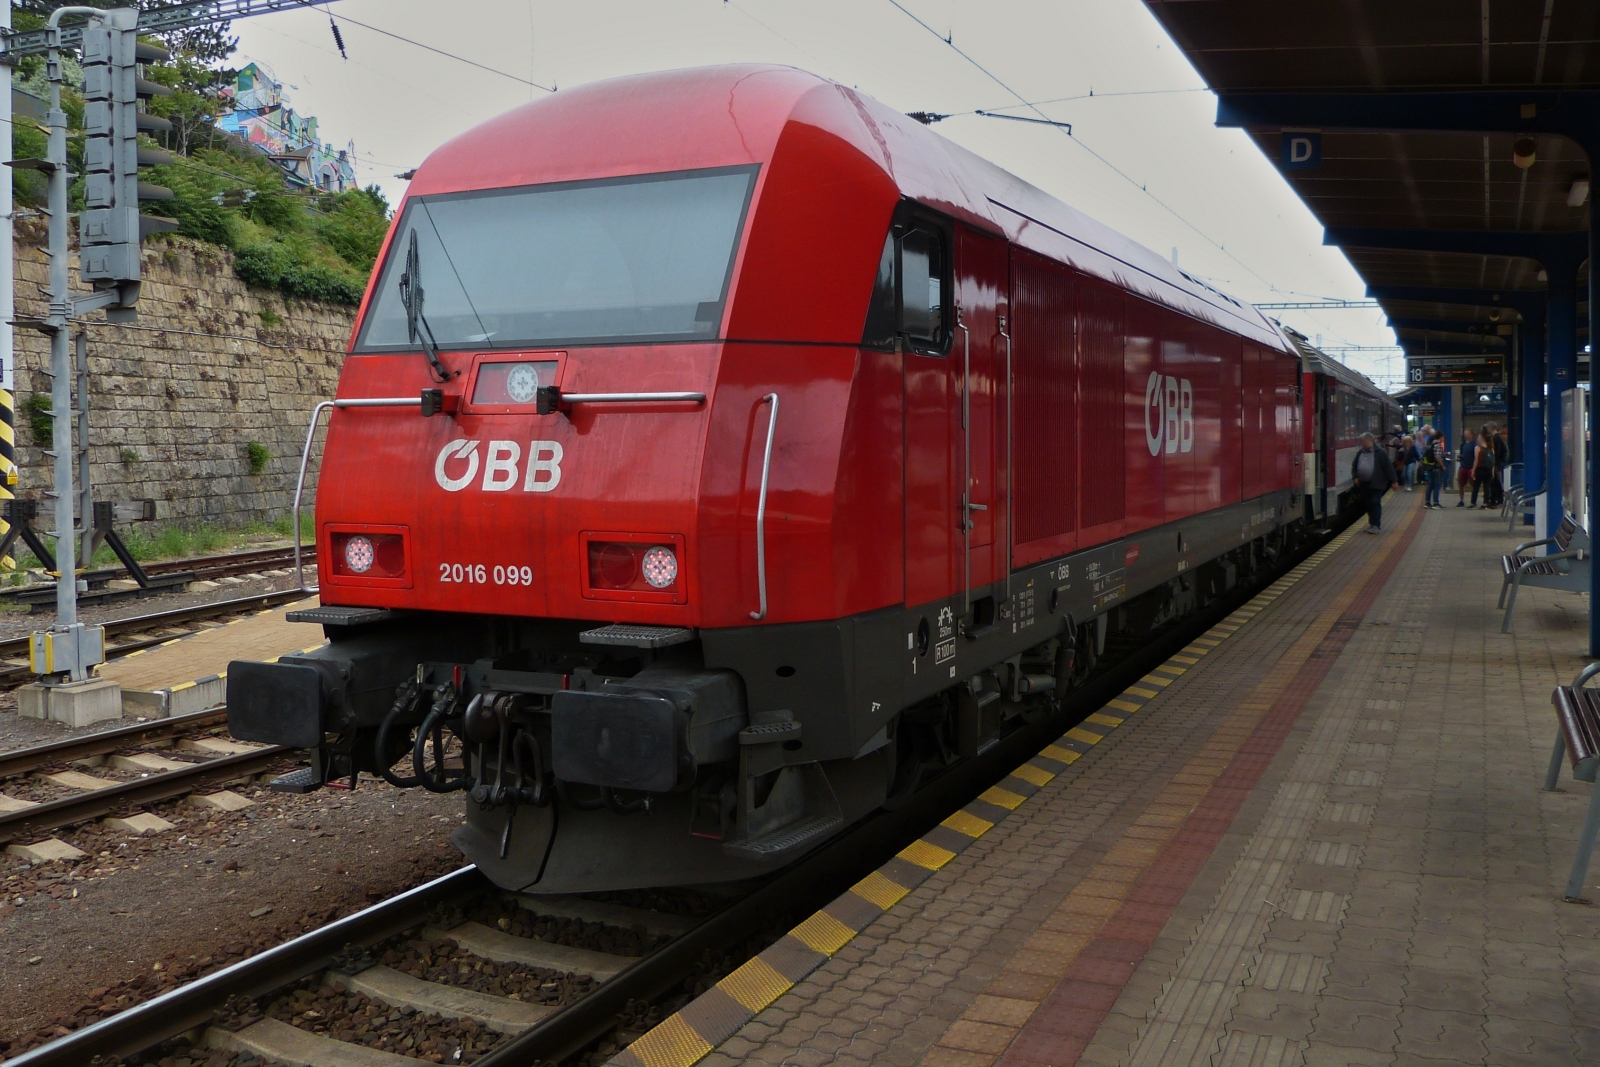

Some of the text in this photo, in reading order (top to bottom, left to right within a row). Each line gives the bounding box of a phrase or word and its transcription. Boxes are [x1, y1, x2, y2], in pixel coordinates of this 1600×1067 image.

[1291, 138, 1312, 162] D
[1410, 368, 1422, 381] 18
[439, 562, 533, 586] 2016 099
